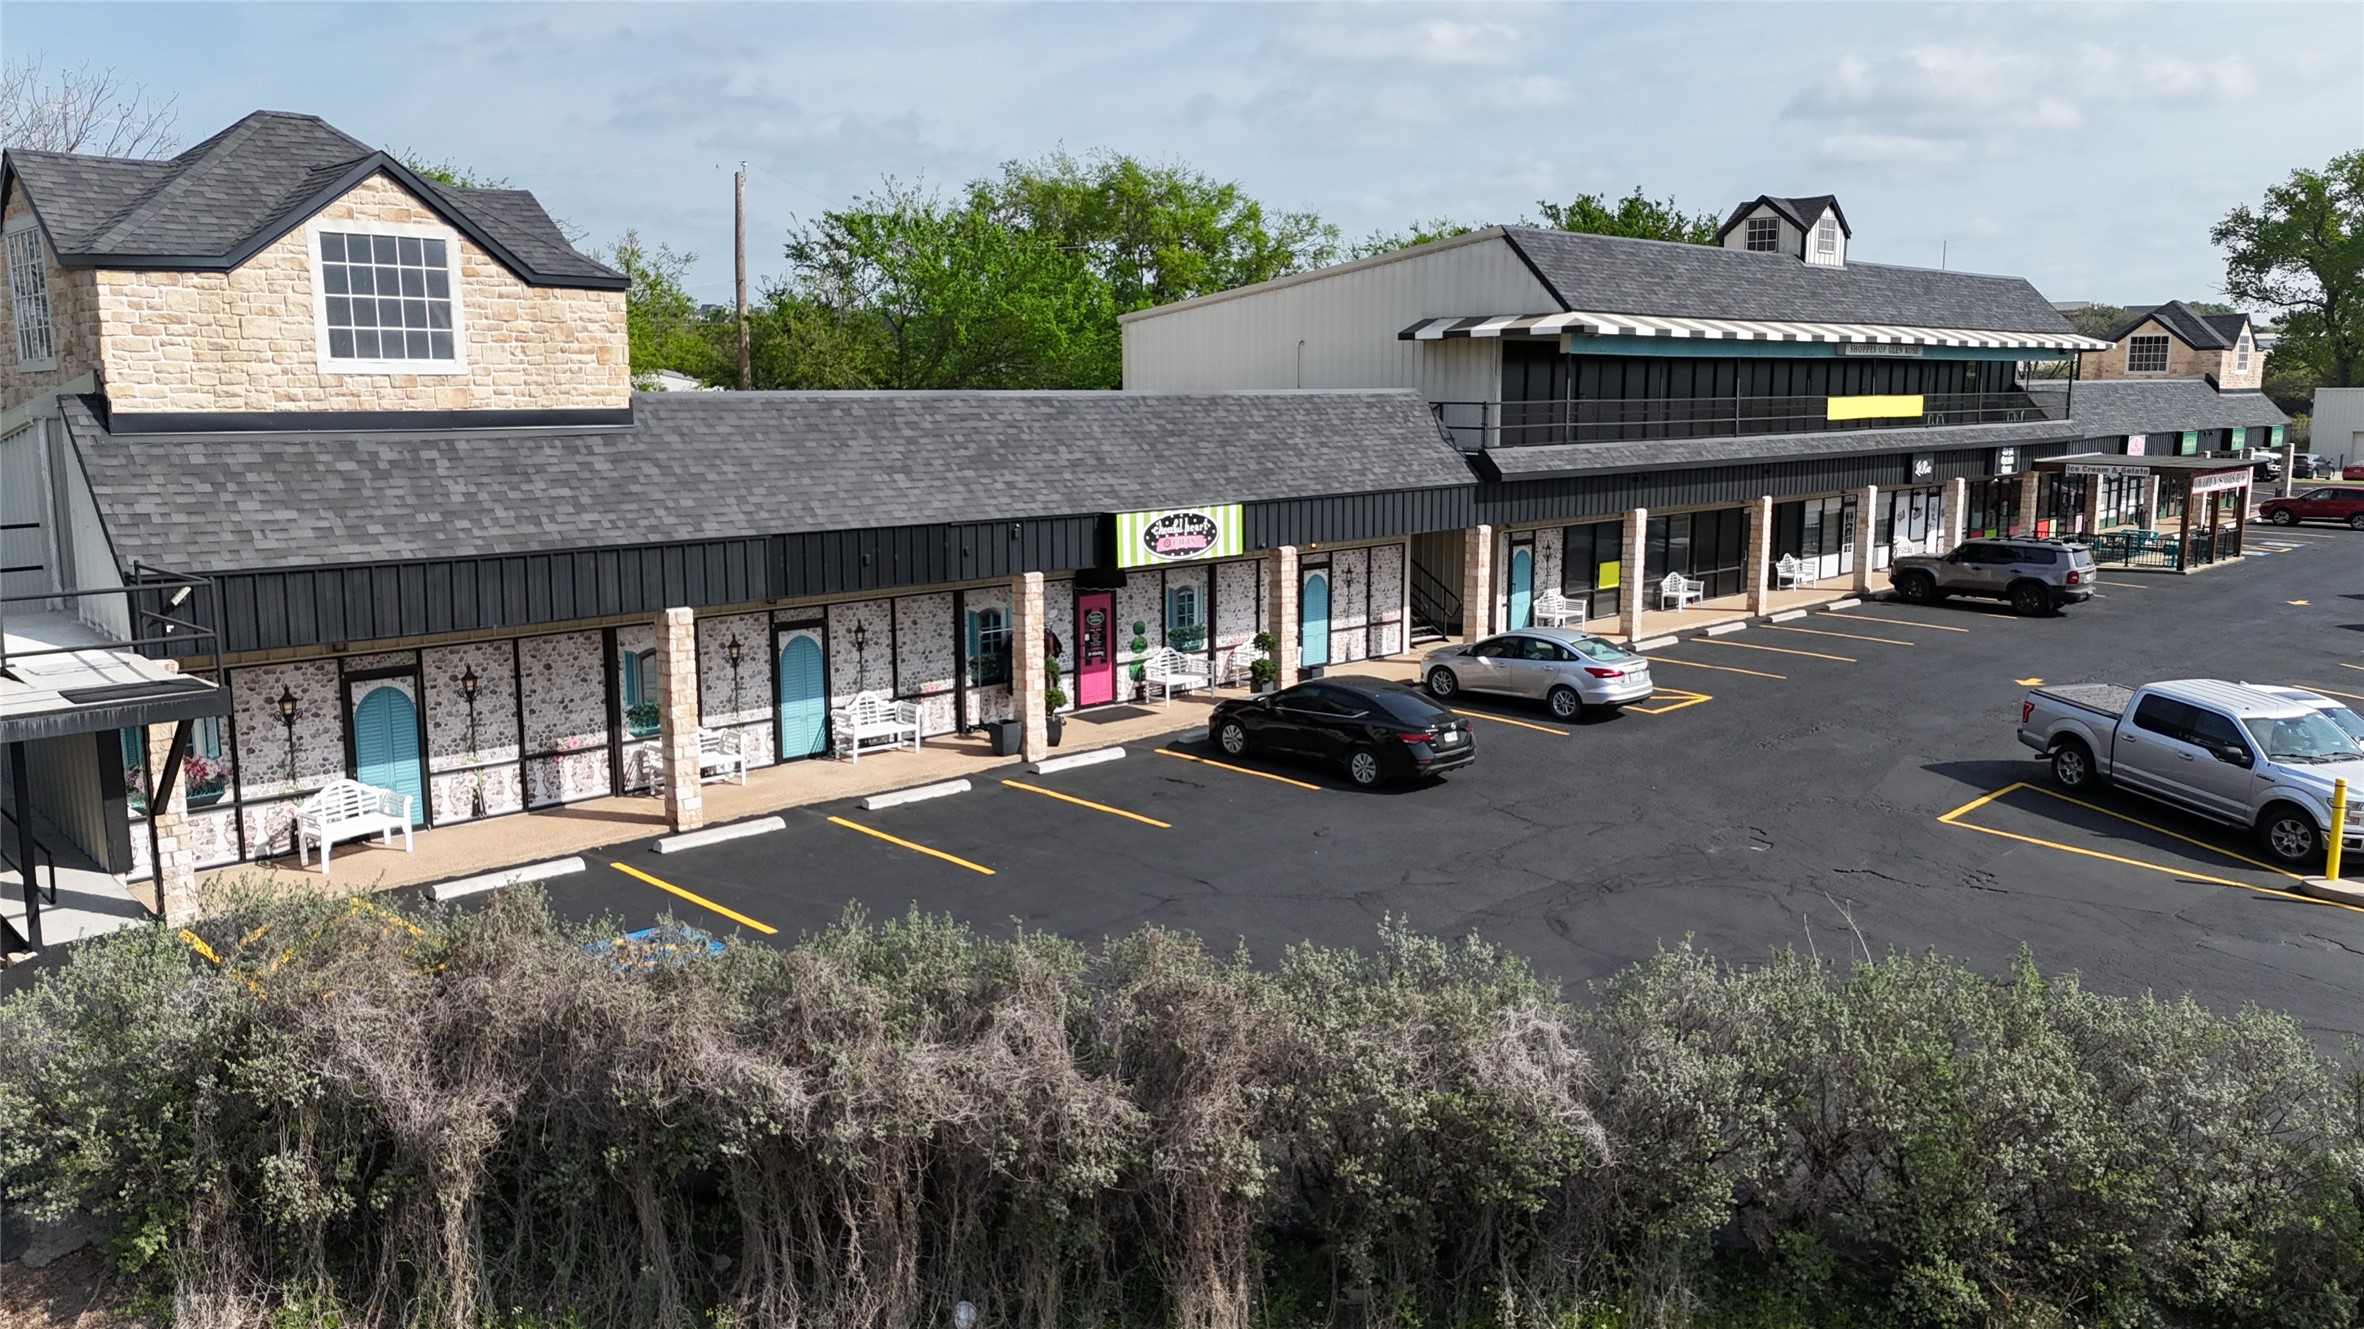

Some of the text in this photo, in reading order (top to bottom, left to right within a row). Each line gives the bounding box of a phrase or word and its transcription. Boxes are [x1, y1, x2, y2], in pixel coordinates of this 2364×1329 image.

[1850, 345, 1919, 355] SHOPPES OF GLEN ROSE
[2121, 467, 2149, 475] Gelato
[1184, 517, 1209, 535] heart
